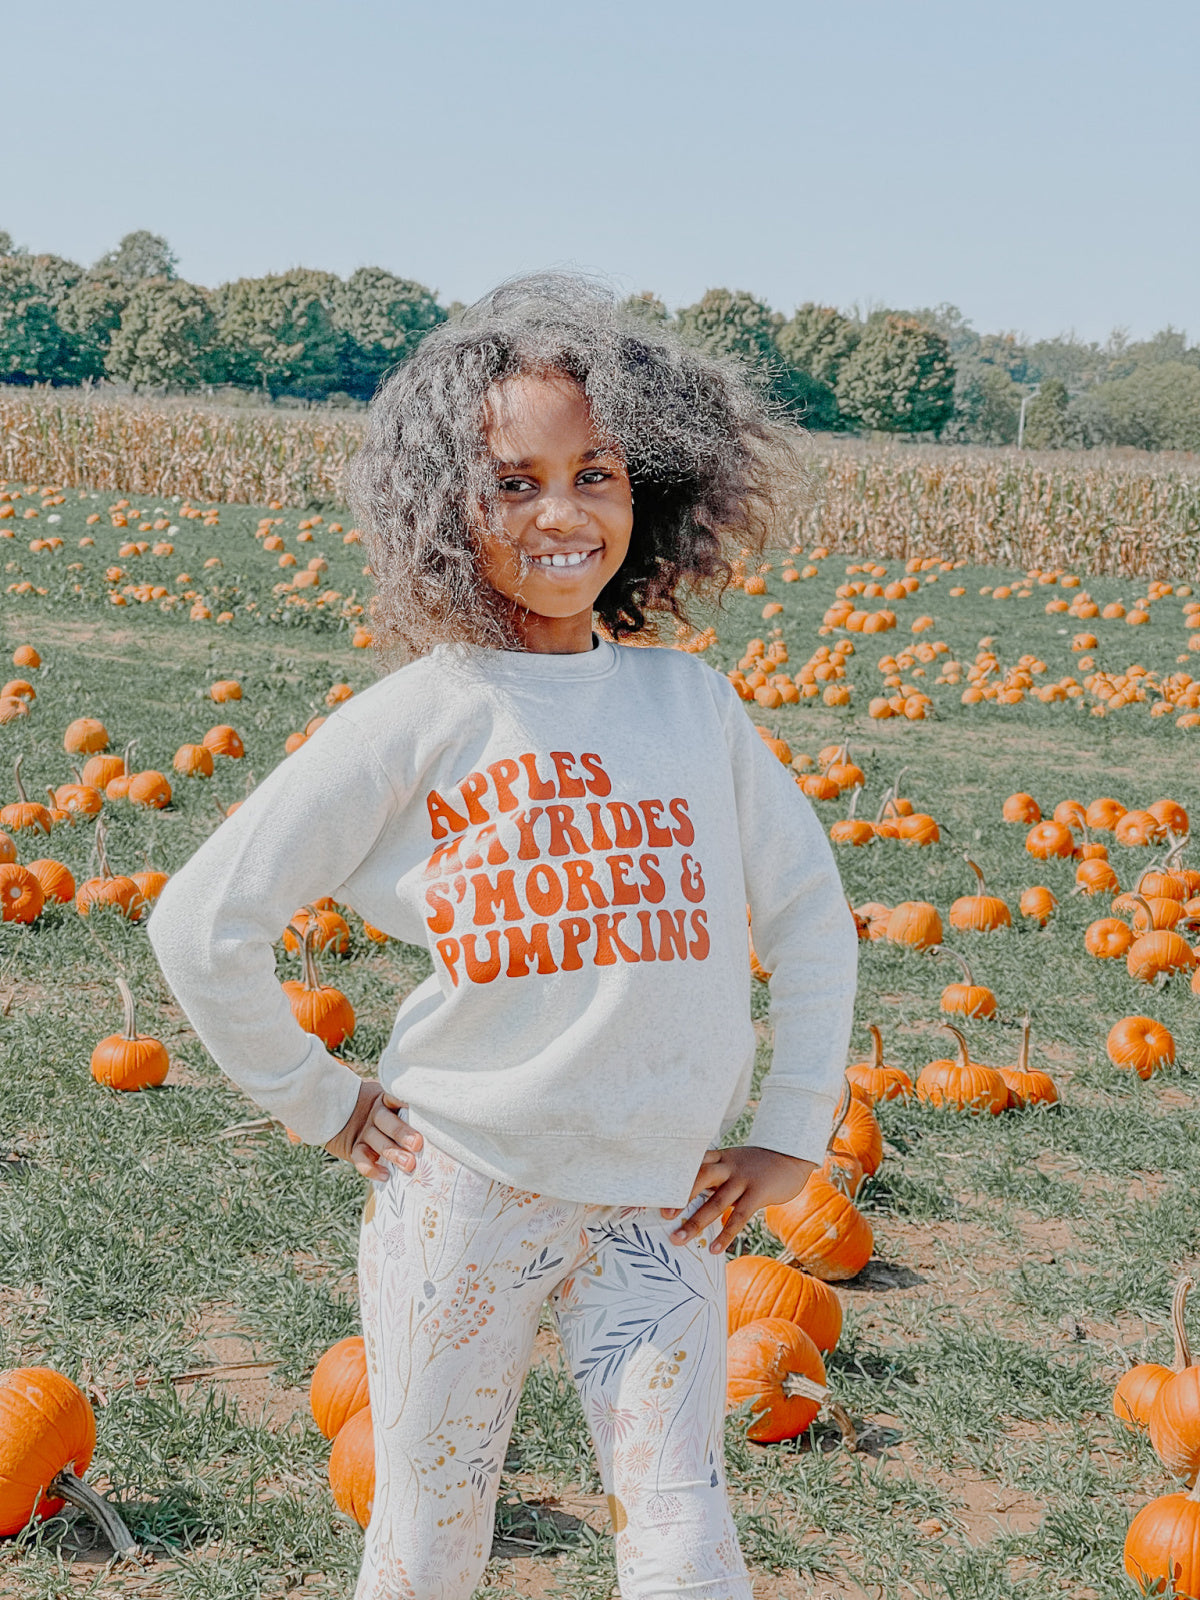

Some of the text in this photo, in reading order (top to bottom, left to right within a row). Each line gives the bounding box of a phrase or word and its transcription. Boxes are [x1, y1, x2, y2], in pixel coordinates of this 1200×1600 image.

[426, 751, 612, 840] APPLES
[425, 853, 706, 935] S'MORES &
[436, 909, 710, 988] PUMPKINS
